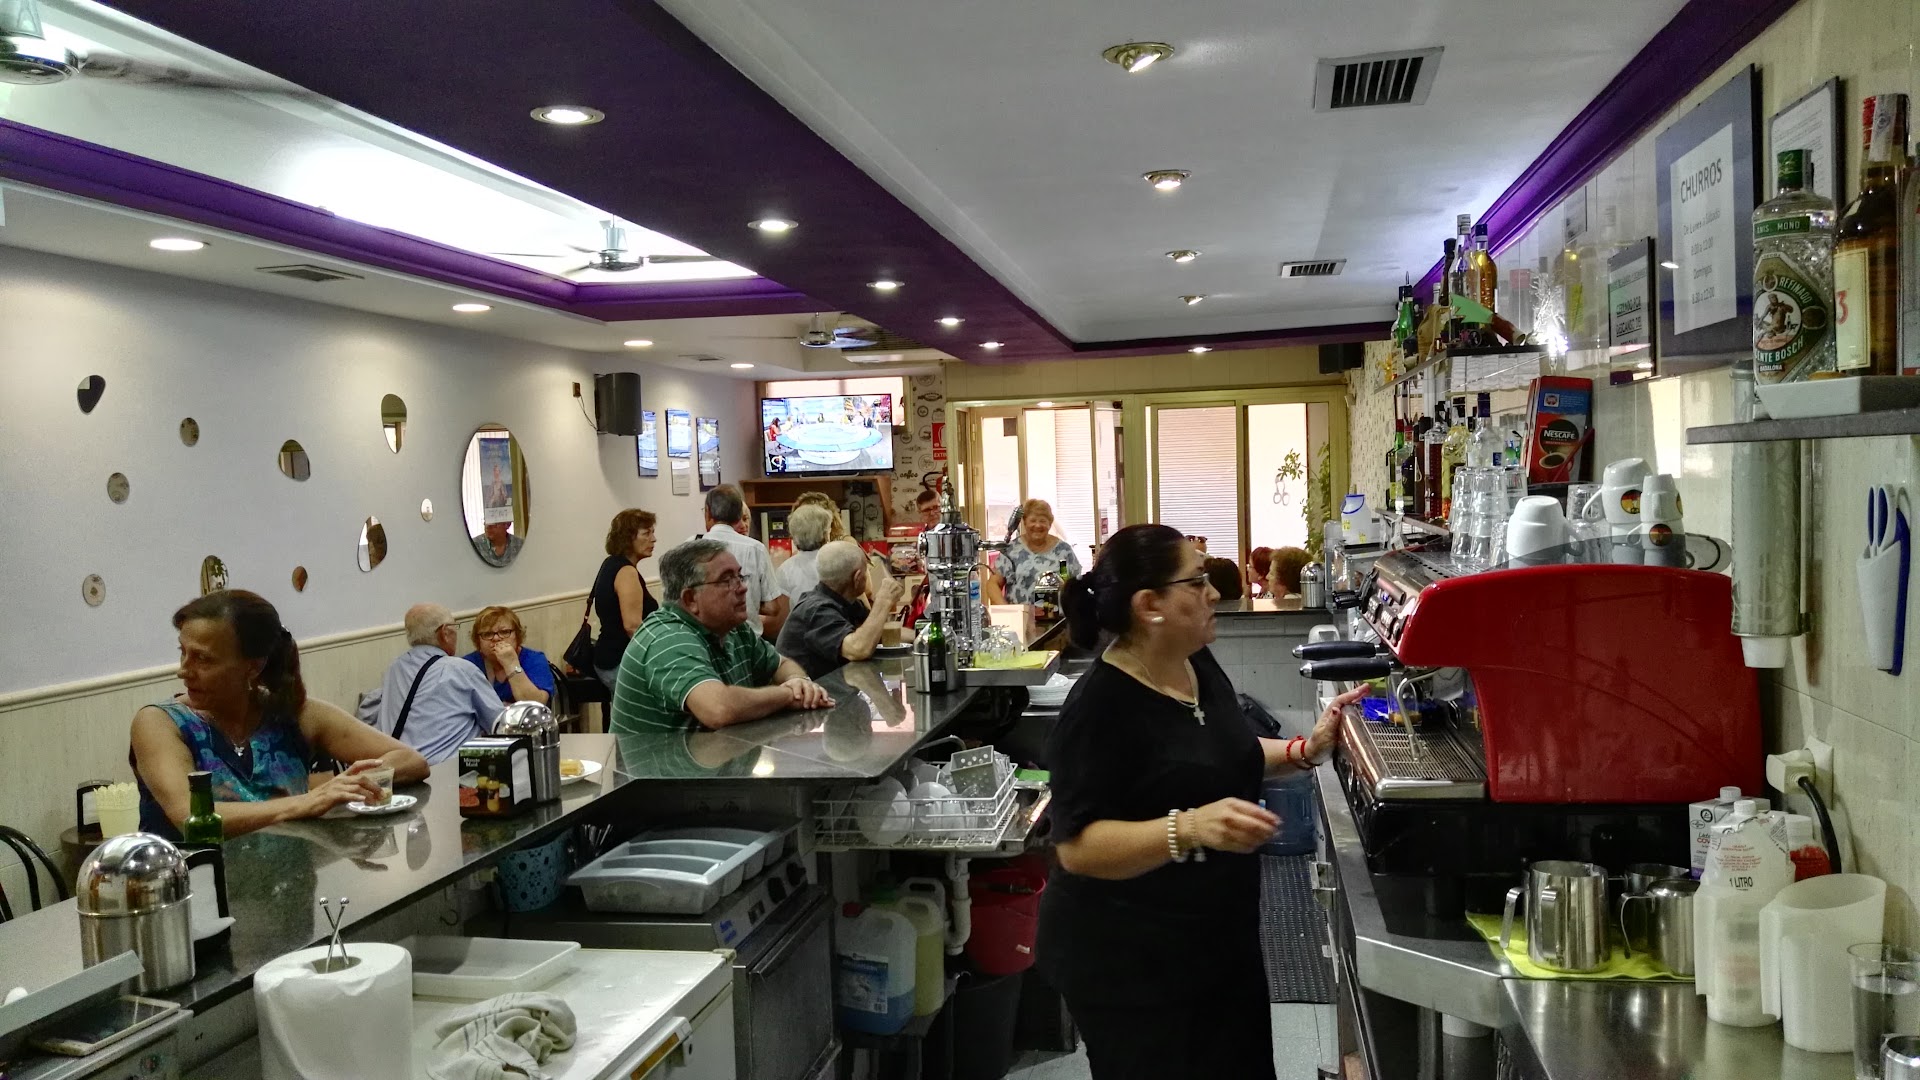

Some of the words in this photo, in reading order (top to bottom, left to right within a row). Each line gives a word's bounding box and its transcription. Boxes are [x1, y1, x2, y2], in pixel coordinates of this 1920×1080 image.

[1680, 158, 1722, 204] CHURROS
[1777, 220, 1801, 231] MONO
[1693, 264, 1713, 280] Domingos
[1779, 277, 1813, 305] REFINADO
[1775, 334, 1804, 362] BOSCH
[1729, 878, 1734, 887] 1
[1734, 876, 1754, 888] LITRO
